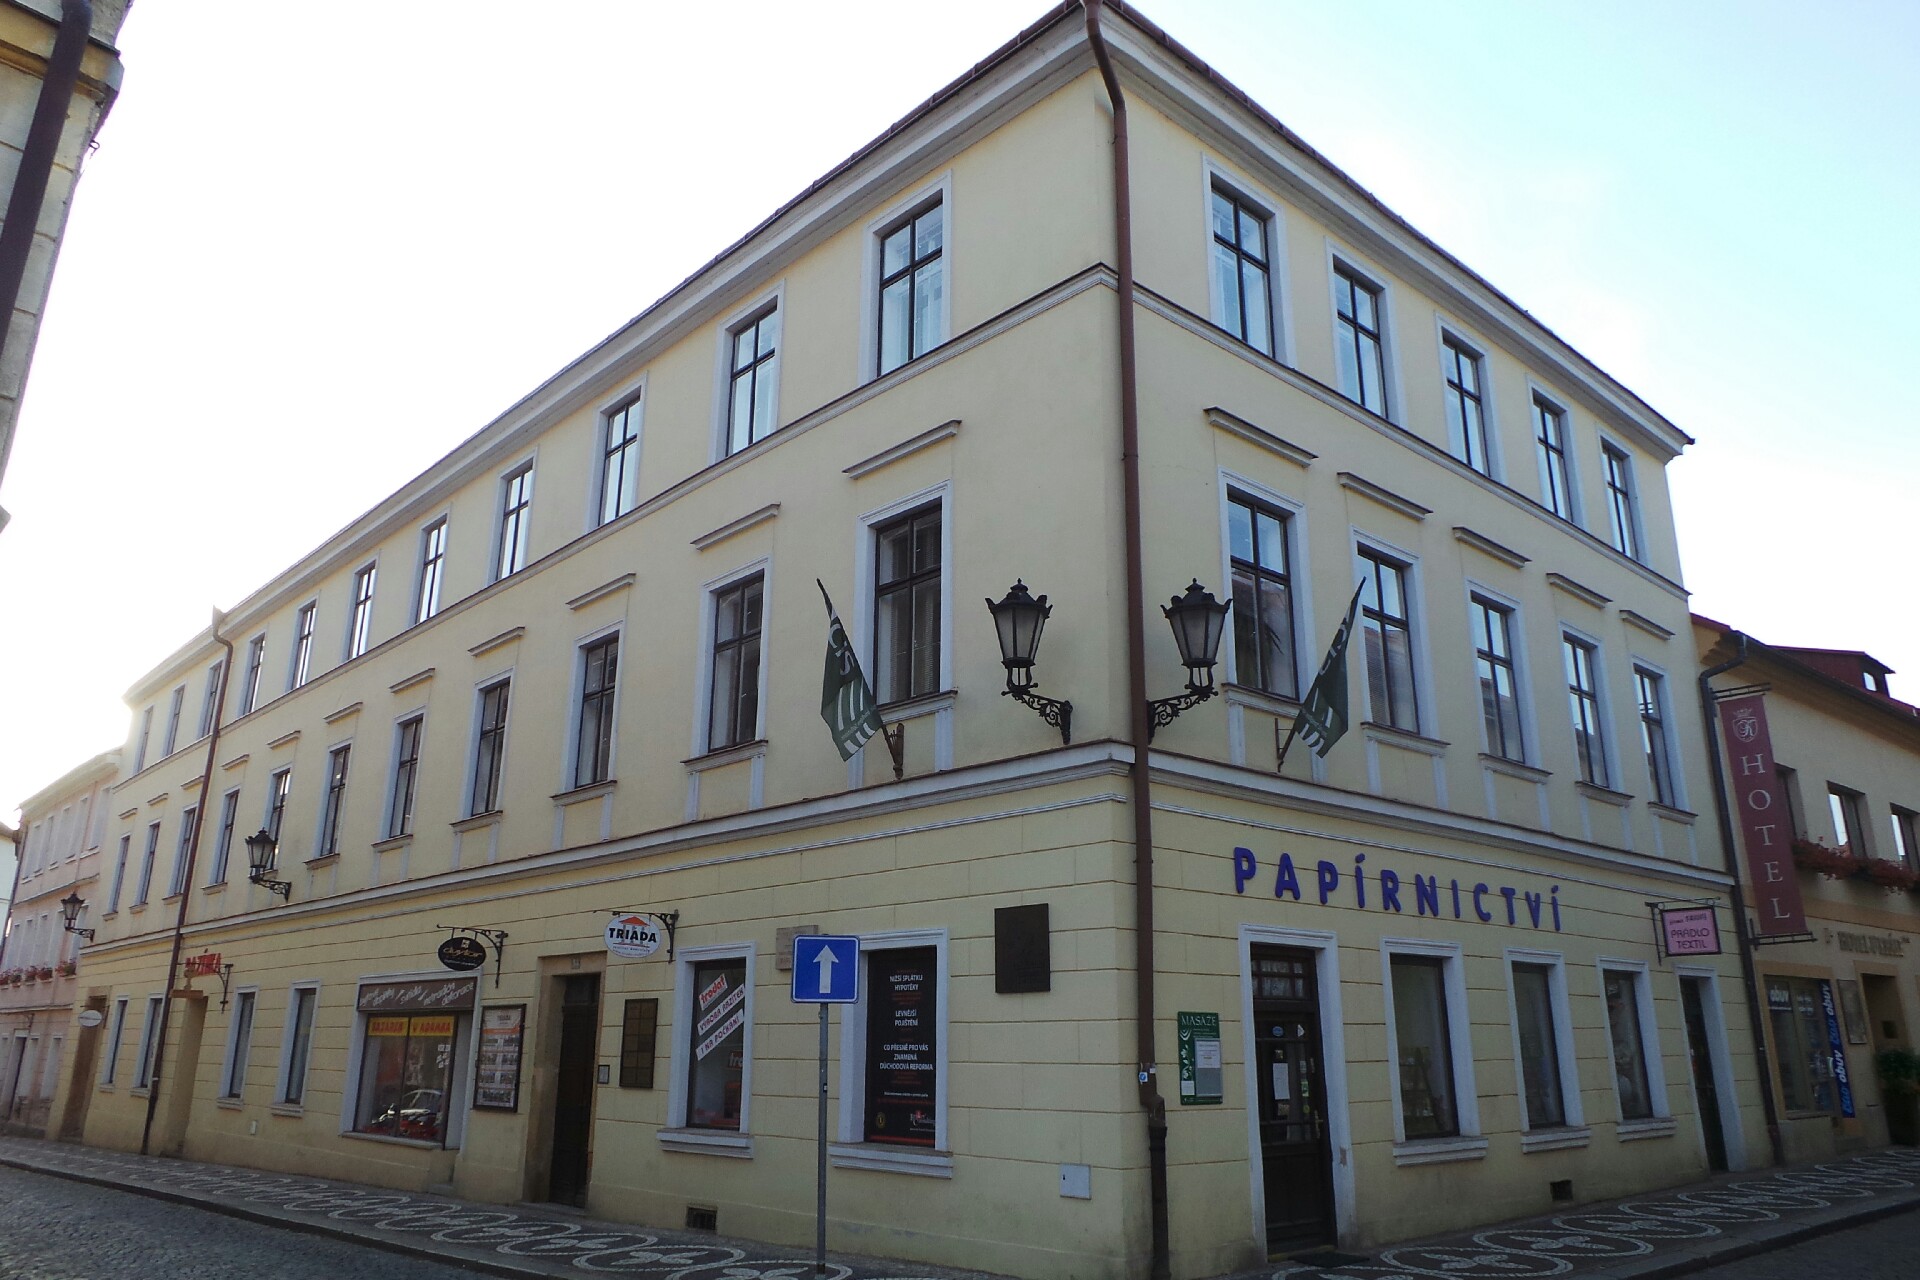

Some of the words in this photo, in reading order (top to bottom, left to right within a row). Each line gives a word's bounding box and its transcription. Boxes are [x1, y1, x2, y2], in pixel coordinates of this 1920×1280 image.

[1741, 753, 1790, 919] HOTEL
[1233, 846, 1561, 932] PAPÍRNICTVÍ
[1676, 940, 1708, 949] TEXTIL
[1822, 984, 1834, 1016] obuv
[909, 1062, 934, 1071] REFORMA
[1834, 1049, 1848, 1083] obuv
